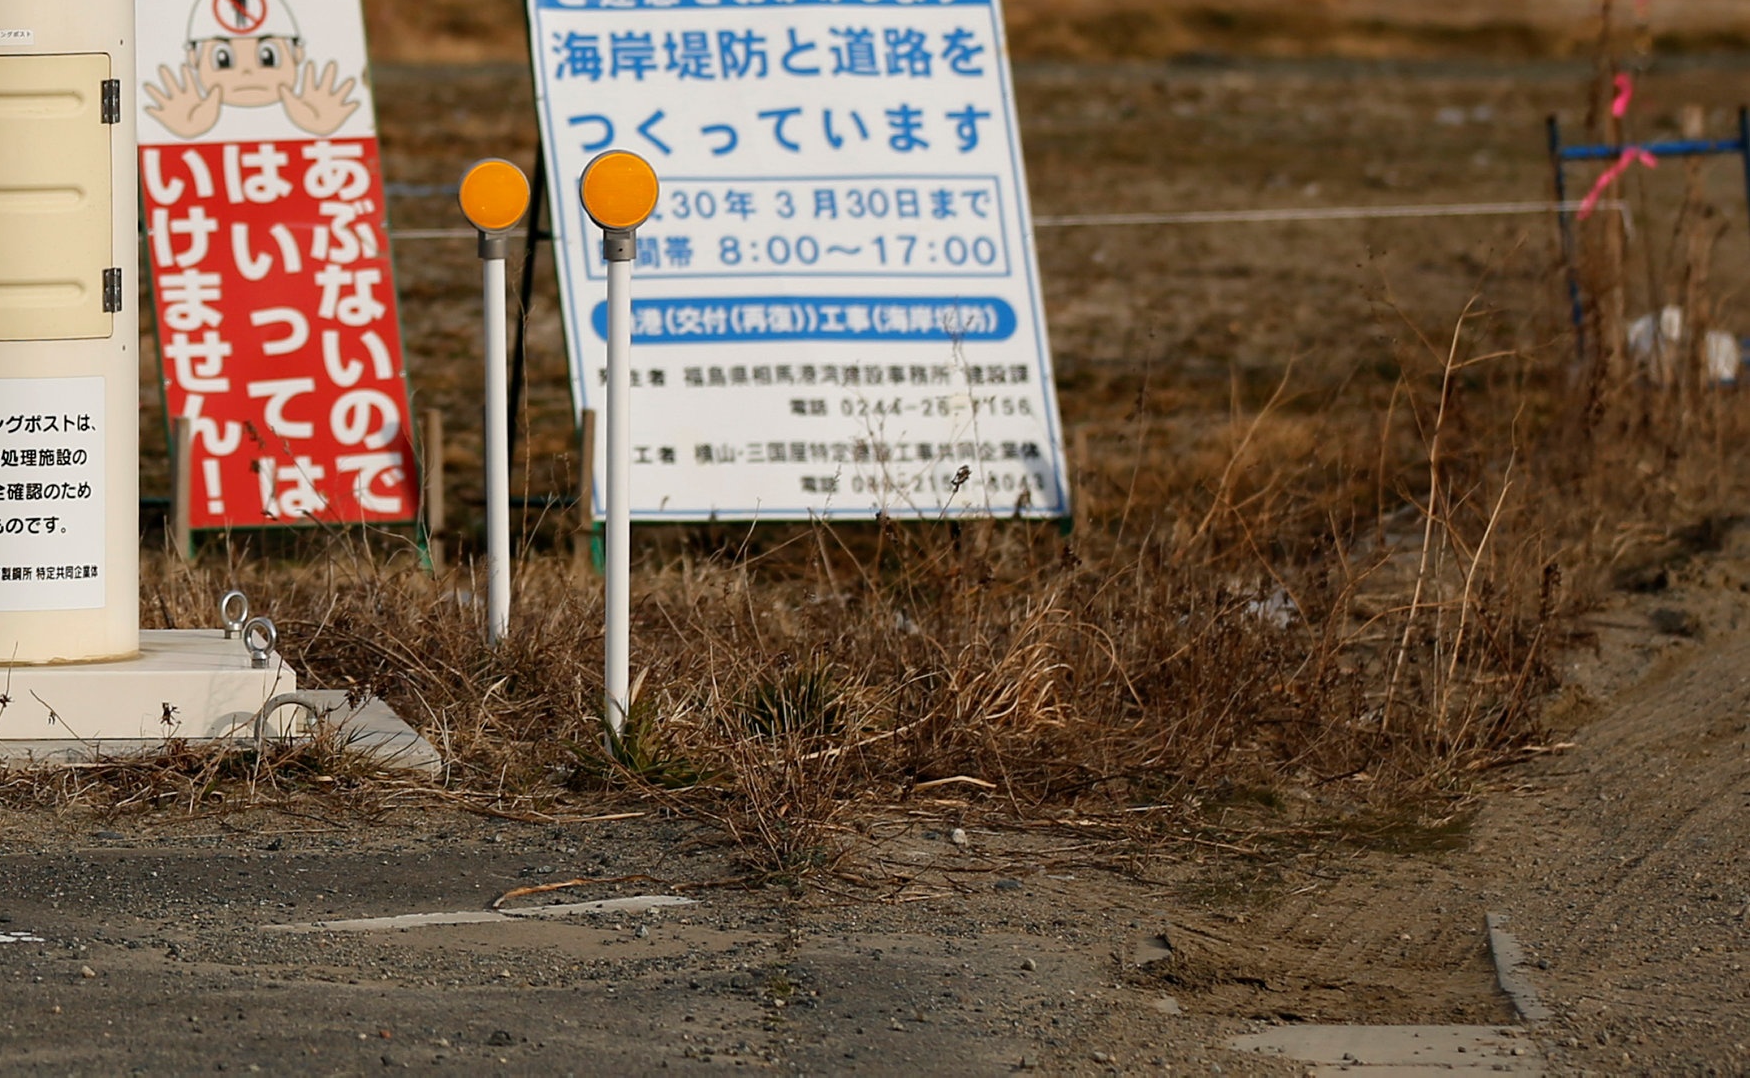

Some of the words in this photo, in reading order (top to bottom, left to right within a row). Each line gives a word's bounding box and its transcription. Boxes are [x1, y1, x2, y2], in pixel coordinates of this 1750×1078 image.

[554, 26, 987, 82] 海岸堤防と道路を
[567, 104, 992, 156] つくっています
[599, 235, 694, 269] 間帯
[223, 144, 326, 518] はいっては
[302, 141, 405, 514] あぶないので
[790, 398, 827, 416] 電話
